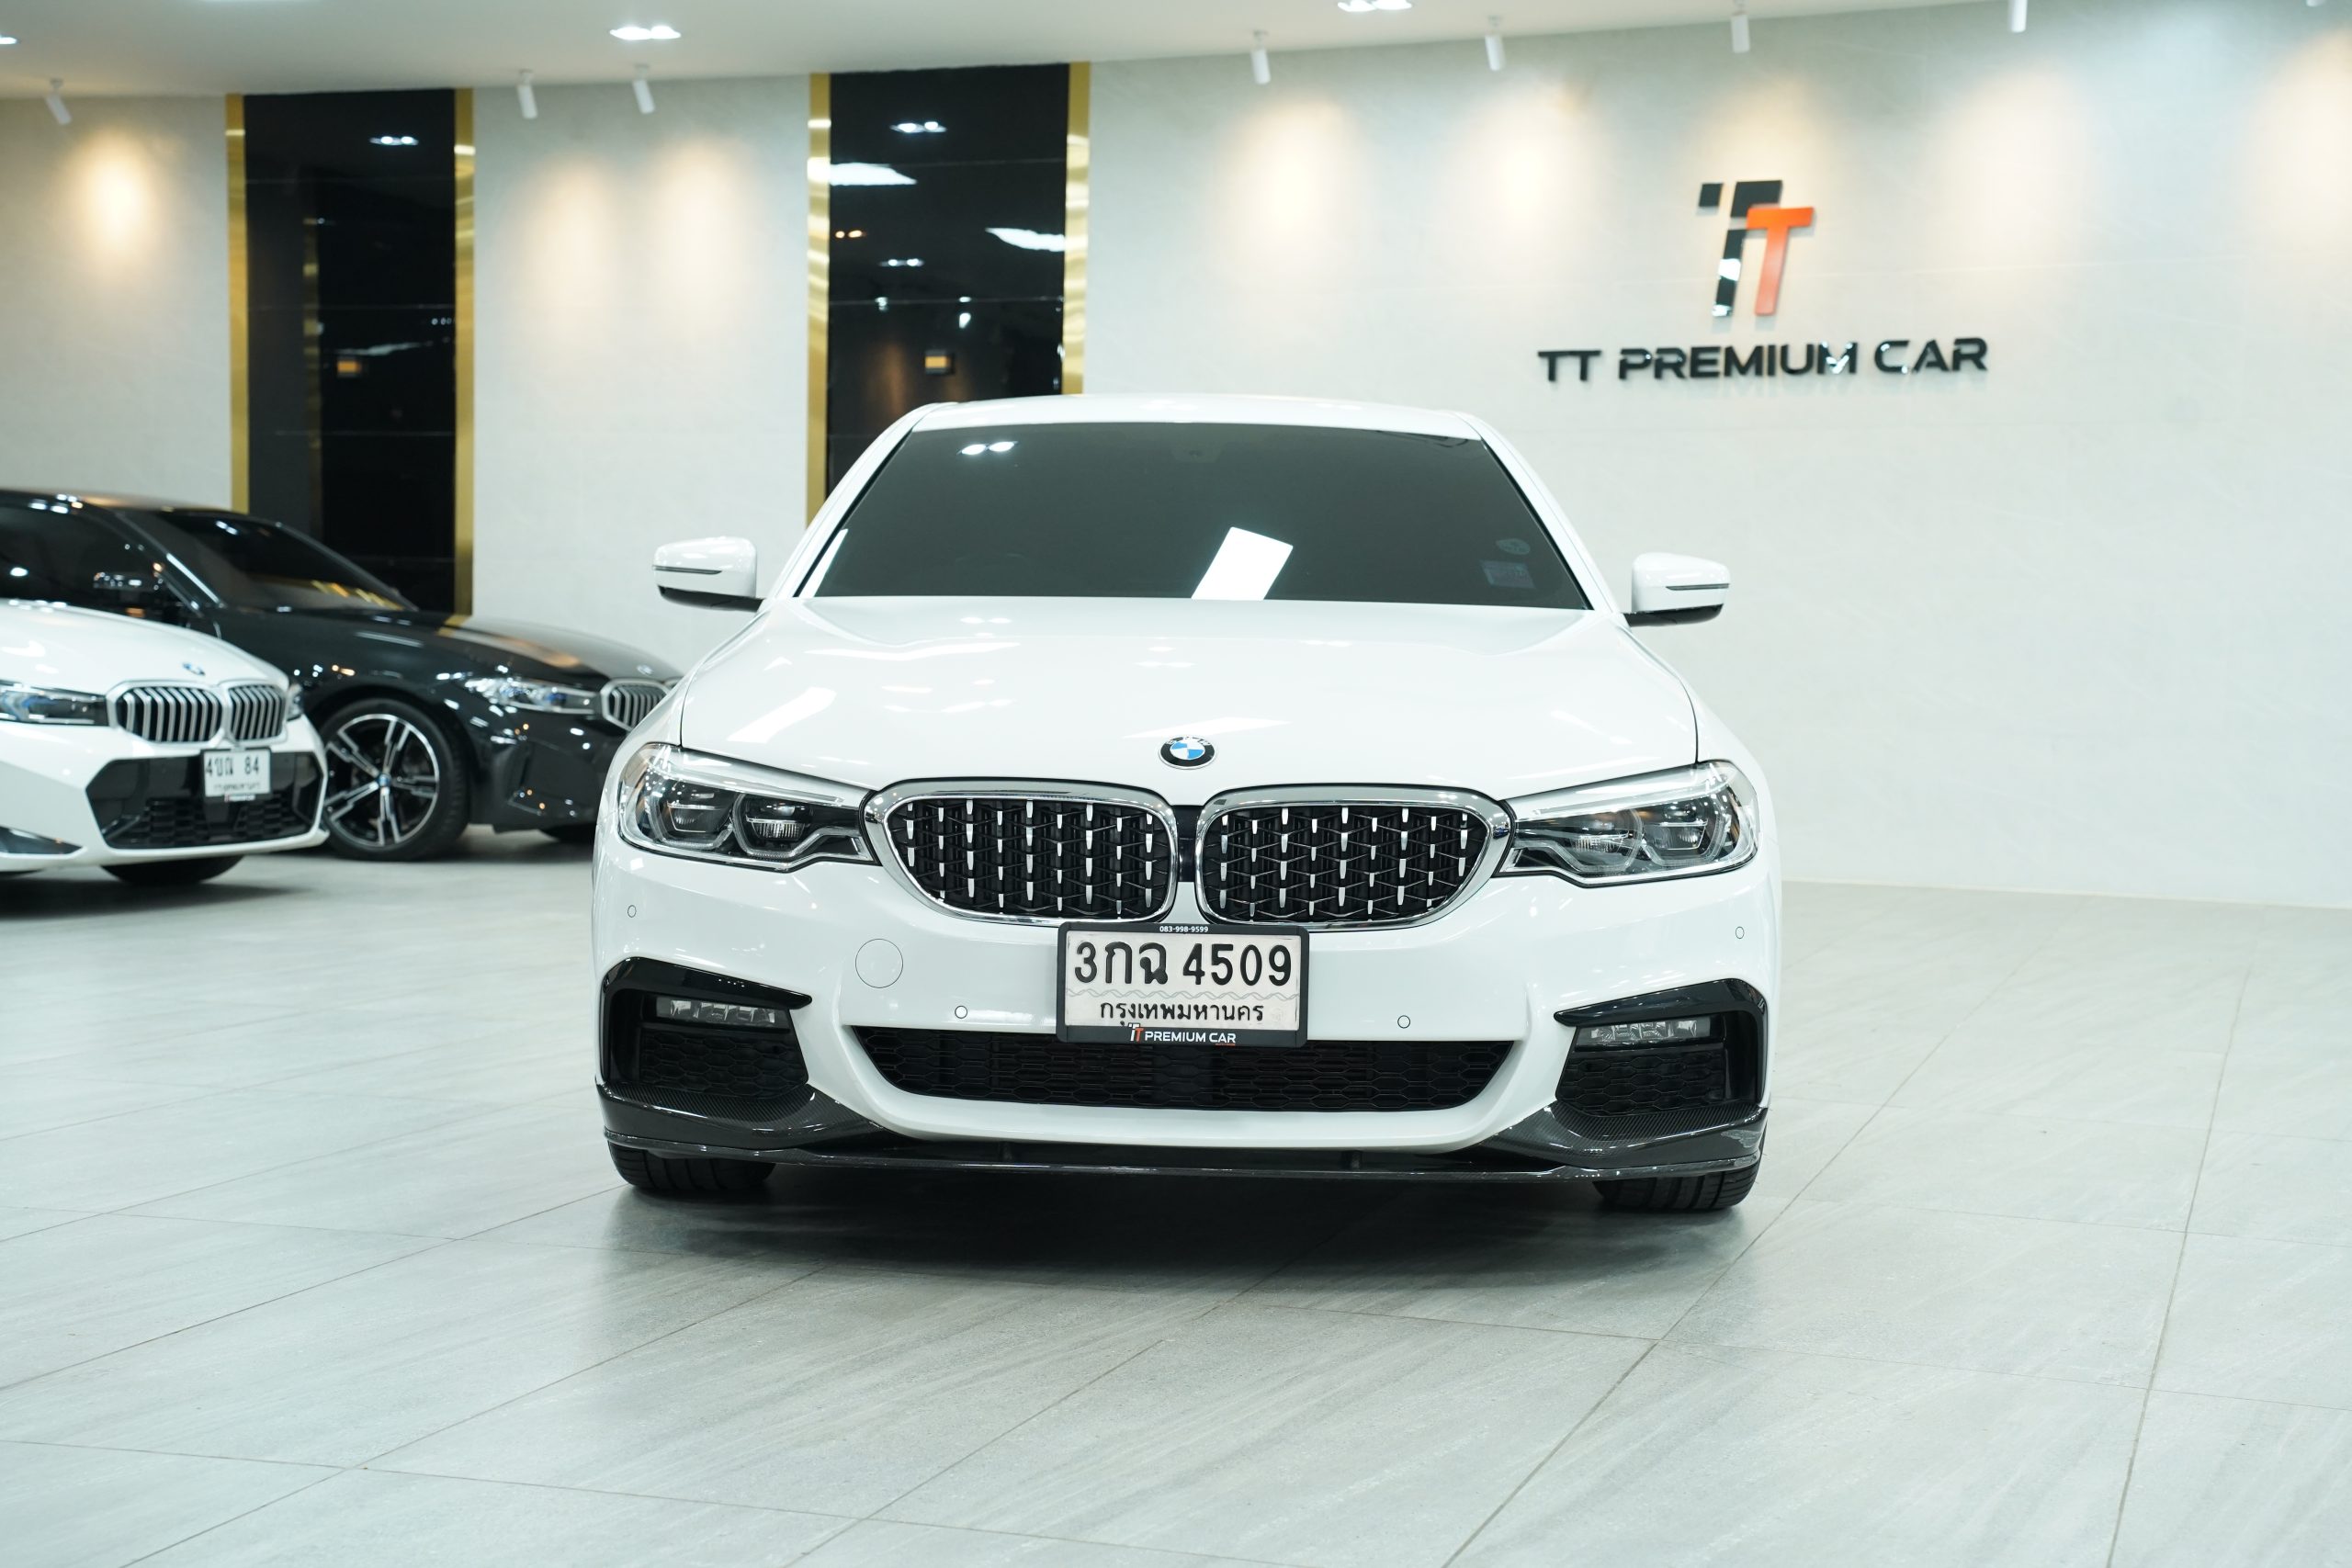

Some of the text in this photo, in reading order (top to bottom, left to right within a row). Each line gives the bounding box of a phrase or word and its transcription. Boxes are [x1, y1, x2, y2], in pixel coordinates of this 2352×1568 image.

[1538, 337, 1988, 382] TT PREMIUM CAR
[244, 756, 259, 775] 84
[1159, 925, 1209, 933] 083-998-9599
[1074, 942, 1292, 987] 3กฉ 4509
[1100, 1001, 1264, 1026] กรุงเทพมหานคร
[1145, 1031, 1206, 1043] PREMIUM
[1208, 1032, 1237, 1043] CAR
